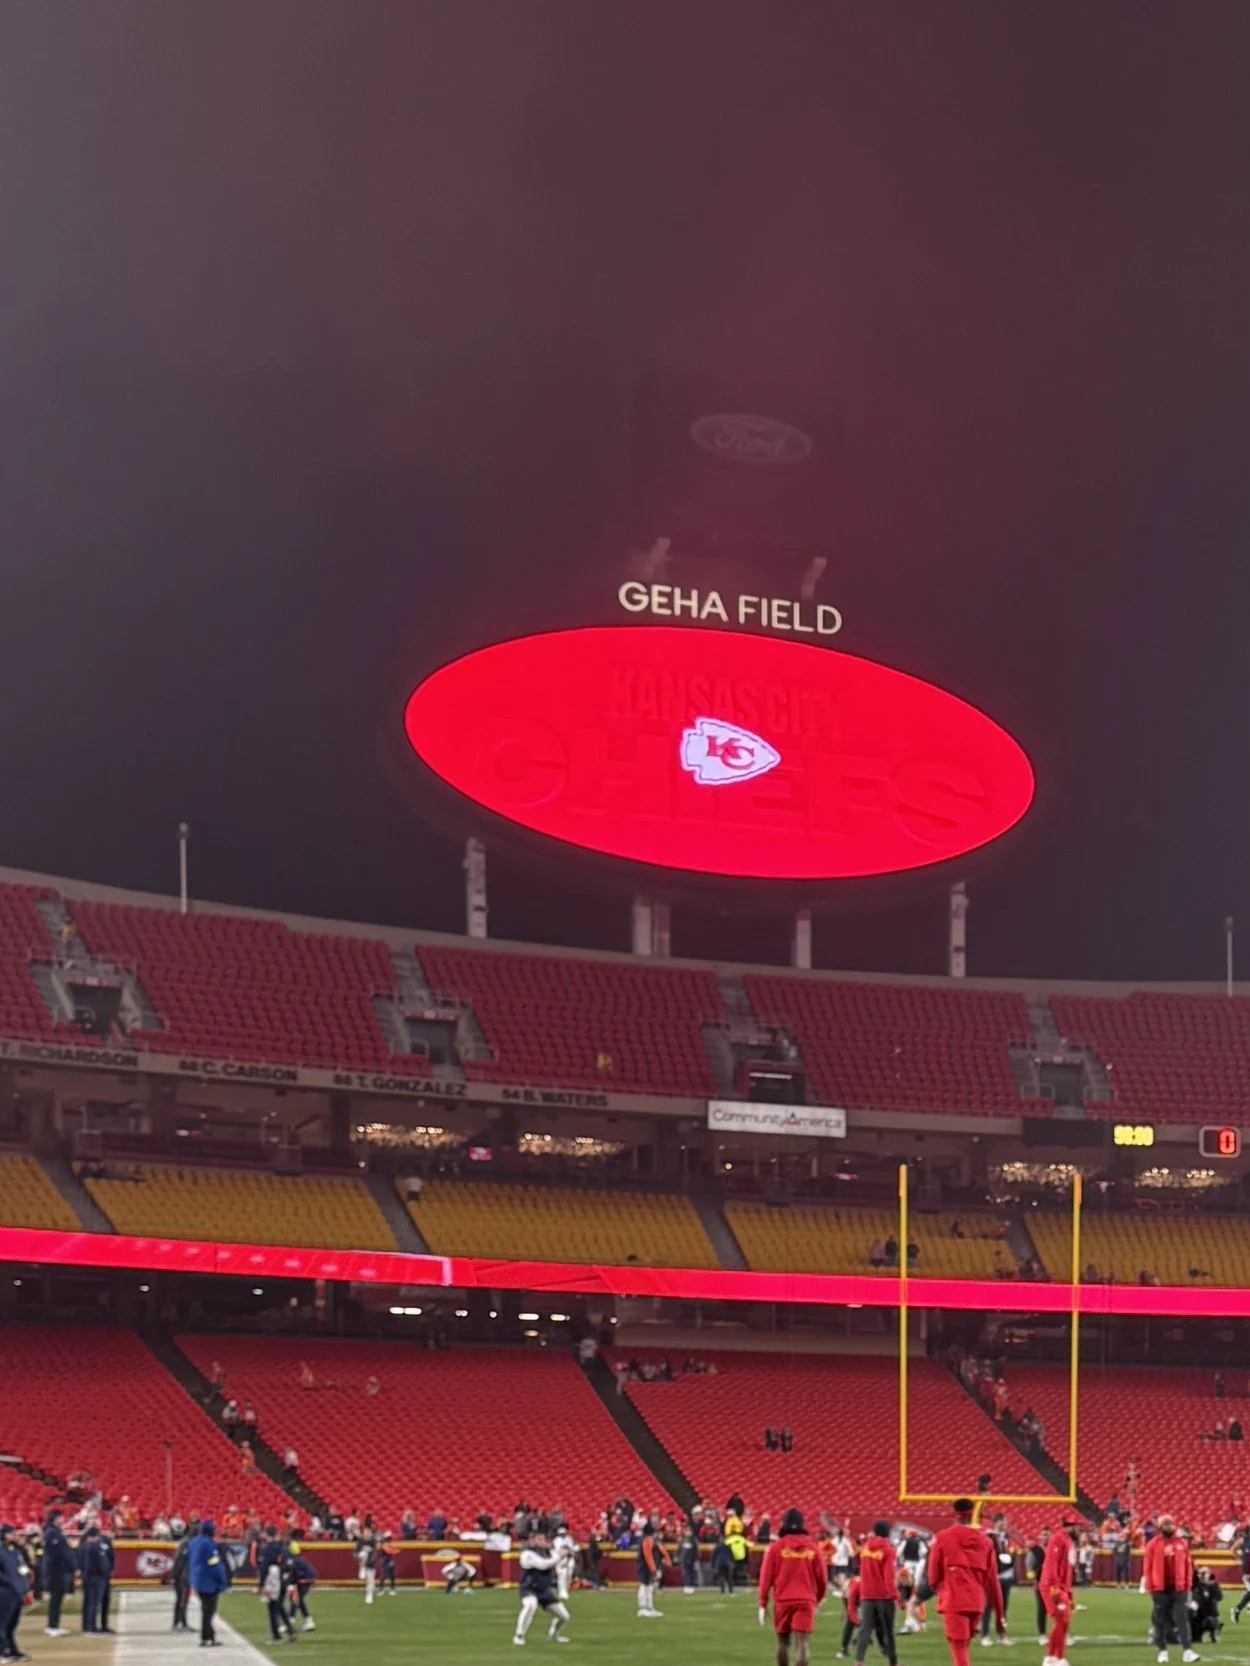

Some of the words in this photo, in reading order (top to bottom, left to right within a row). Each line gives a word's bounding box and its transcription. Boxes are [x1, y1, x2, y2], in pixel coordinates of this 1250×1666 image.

[618, 581, 729, 622] GEHA
[739, 594, 842, 634] FIELD
[609, 666, 757, 727] KANSAS
[758, 682, 842, 737] CITY
[222, 1061, 298, 1082] CARSON
[371, 1075, 468, 1098] GONZALEZ
[540, 1091, 608, 1108] WATERS
[1219, 1127, 1237, 1154] 0
